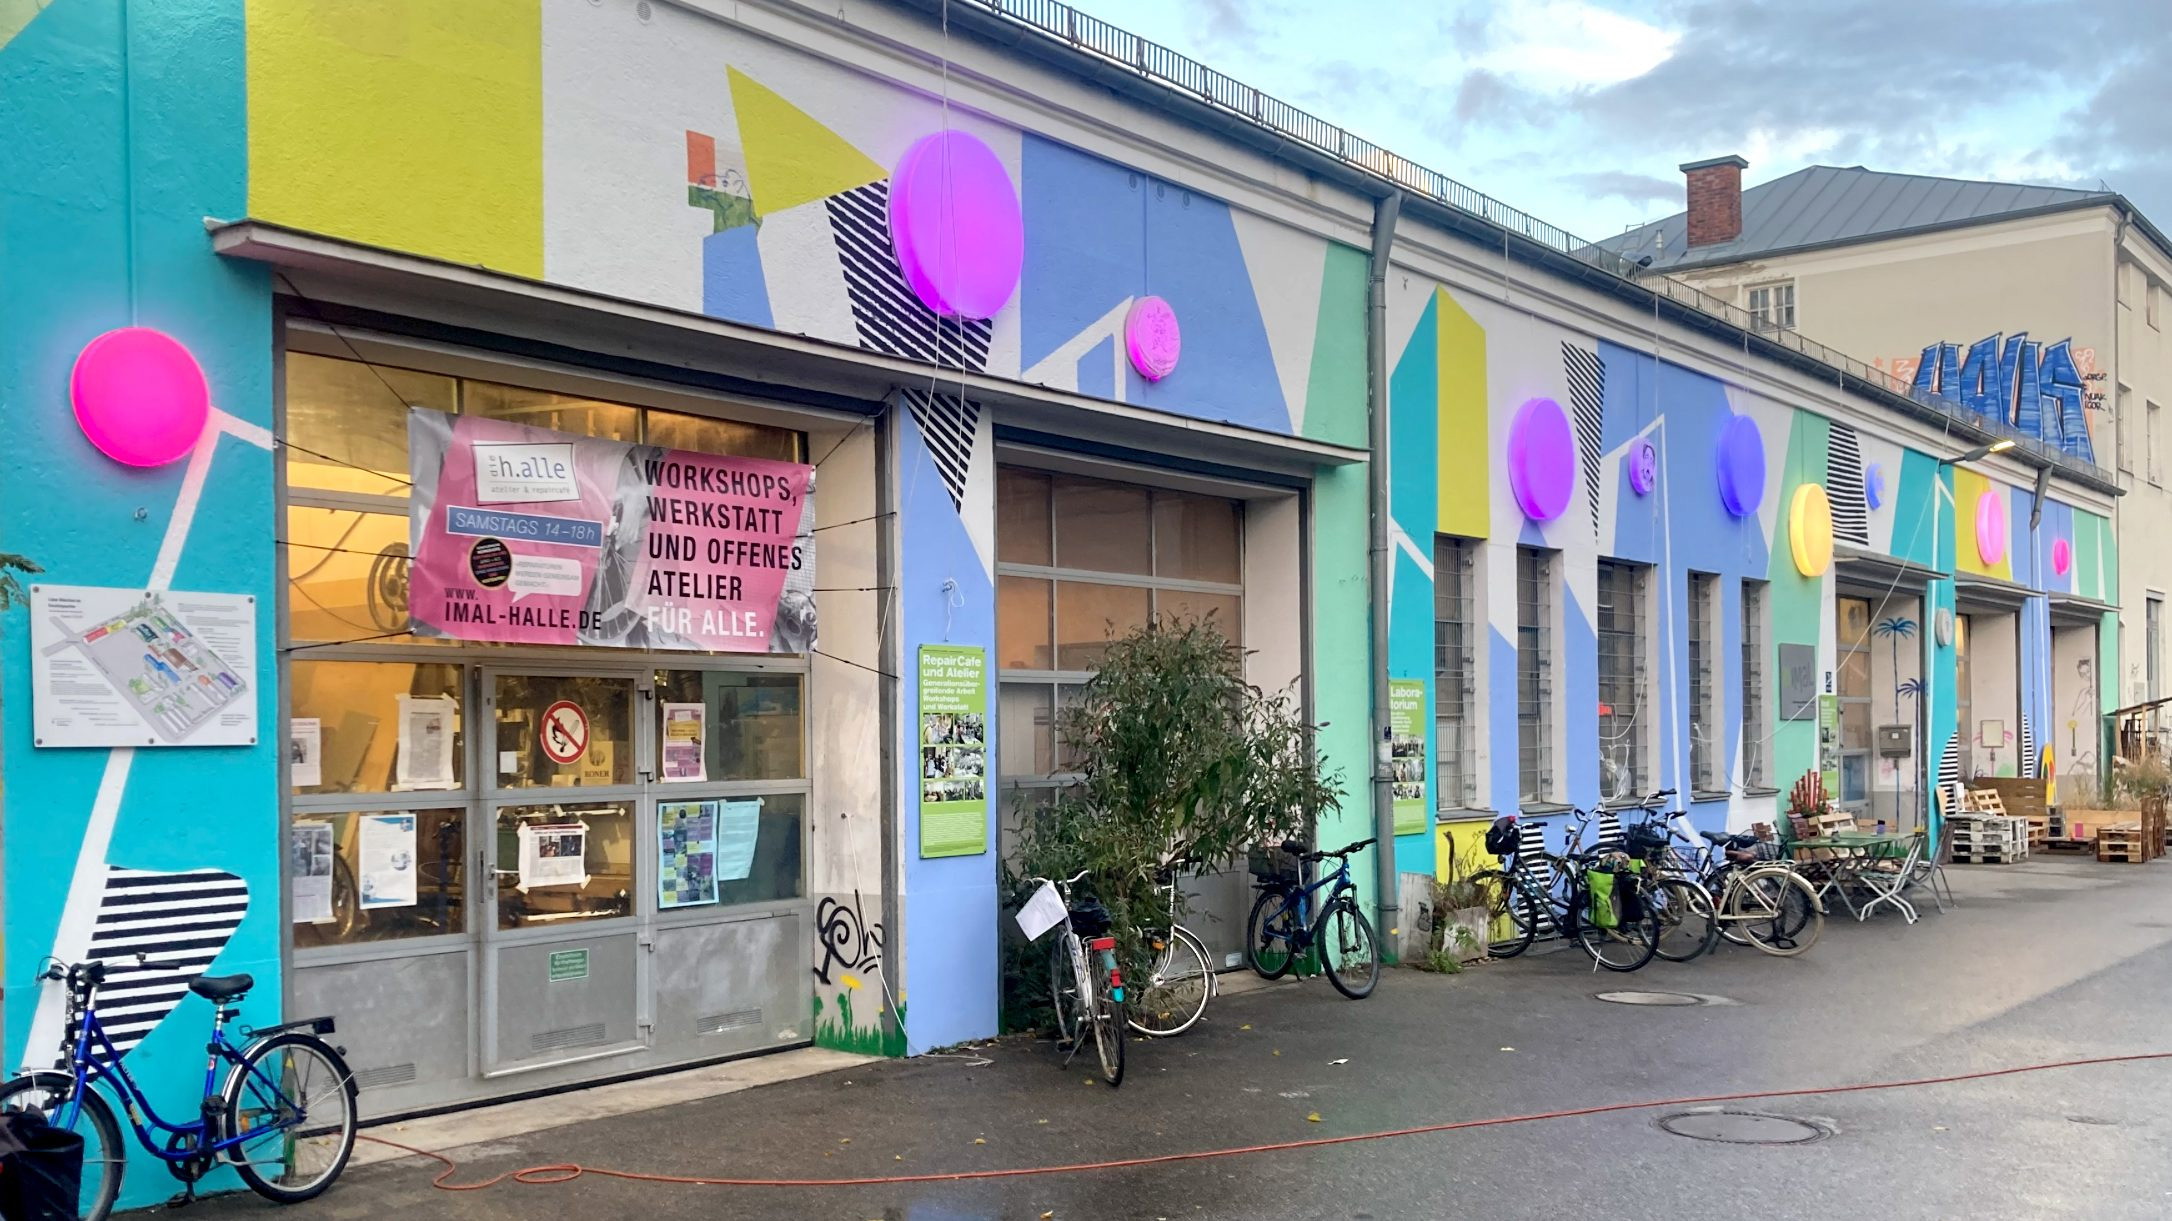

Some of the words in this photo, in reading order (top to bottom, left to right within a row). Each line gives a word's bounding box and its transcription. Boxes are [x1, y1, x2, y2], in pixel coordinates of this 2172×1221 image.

[499, 456, 566, 479] h.alle
[645, 459, 797, 506] WORKSHOPS,
[455, 513, 539, 535] SAMSTAGS
[646, 496, 783, 534] WERKSTATT
[649, 532, 696, 562] UND
[707, 538, 802, 570] OFFENES
[648, 569, 742, 601] ATELIER
[445, 602, 602, 630] IMAL-HALLE.DE
[646, 602, 692, 635] FÜR
[701, 609, 764, 637] ALLE.
[923, 667, 943, 677] und
[946, 667, 980, 678] Atelier
[1390, 685, 1423, 698] Labora-
